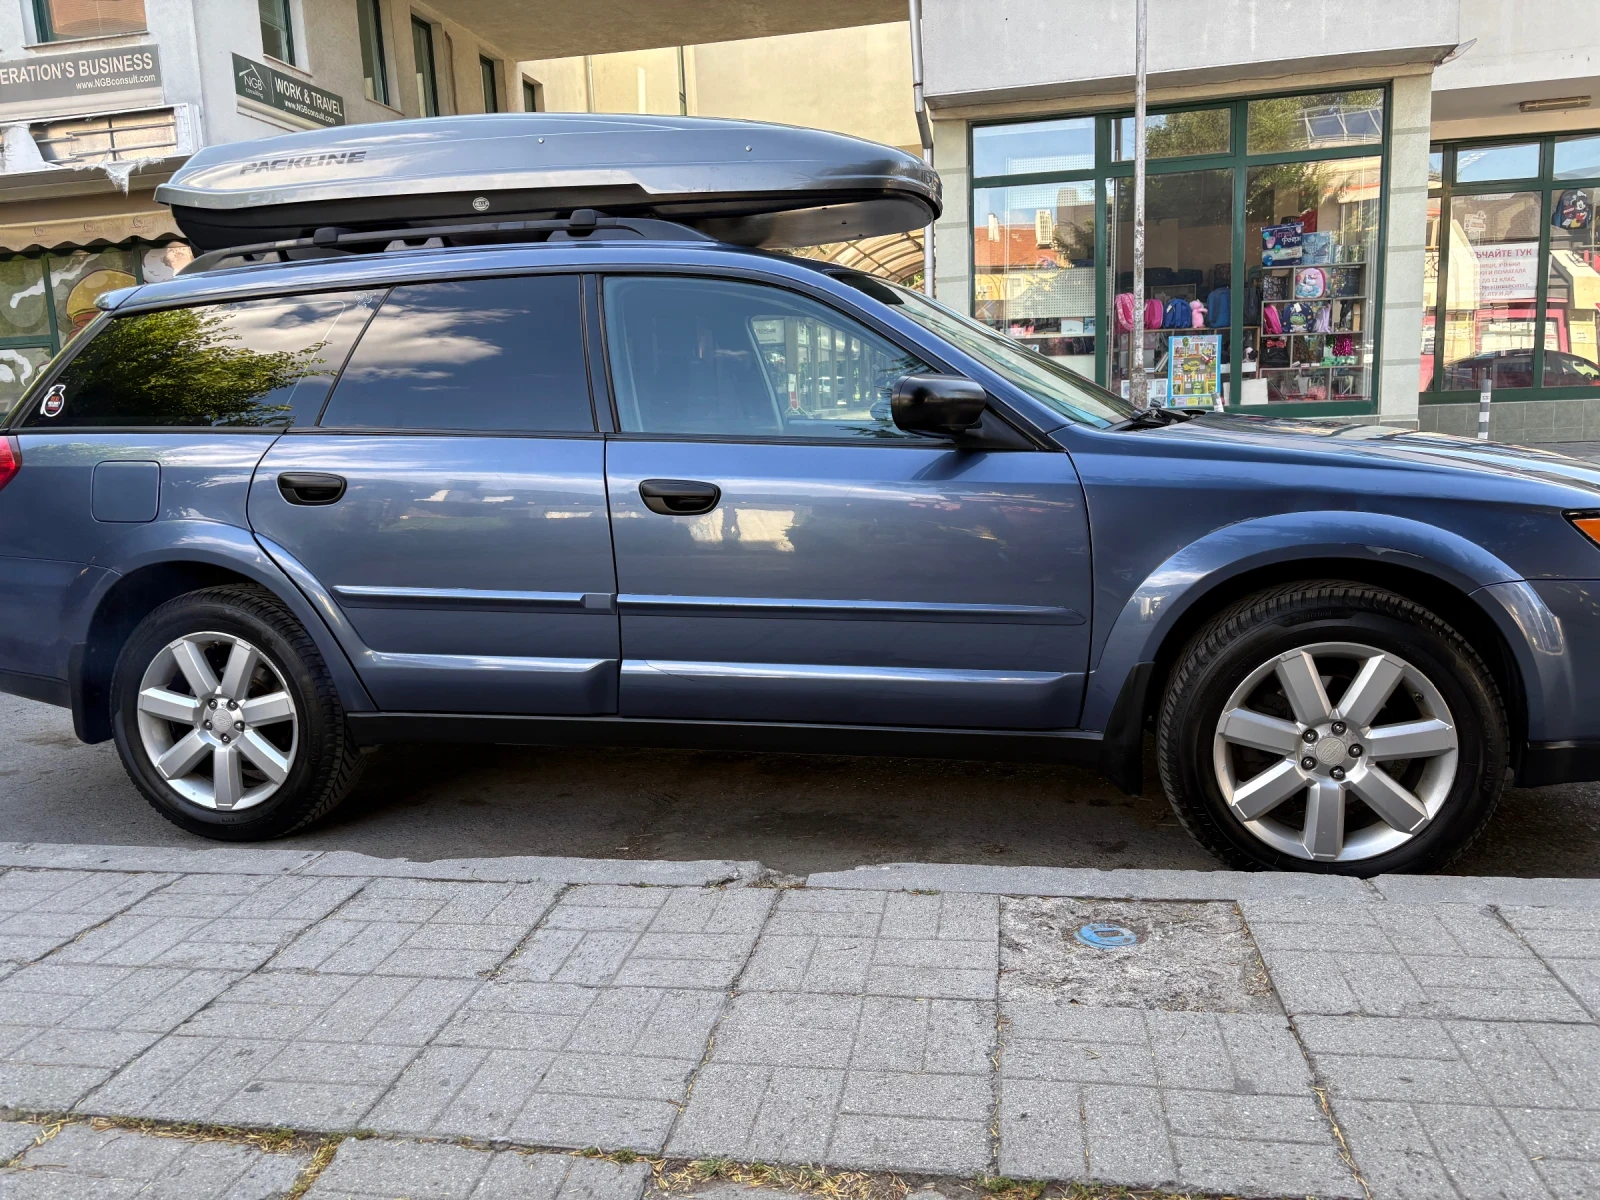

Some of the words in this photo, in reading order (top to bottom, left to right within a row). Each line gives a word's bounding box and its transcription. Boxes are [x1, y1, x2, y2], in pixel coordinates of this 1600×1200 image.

[79, 52, 153, 77] BUSINESS
[75, 74, 156, 90] www.NGBconsult.com
[243, 74, 263, 91] NGB
[274, 76, 303, 102] WORK
[303, 88, 311, 105] &
[310, 91, 343, 117] TRAVEL
[283, 99, 336, 125] www.NGBconsult.com
[239, 150, 368, 175] PACKLINE
[1515, 248, 1533, 256] ТУК
